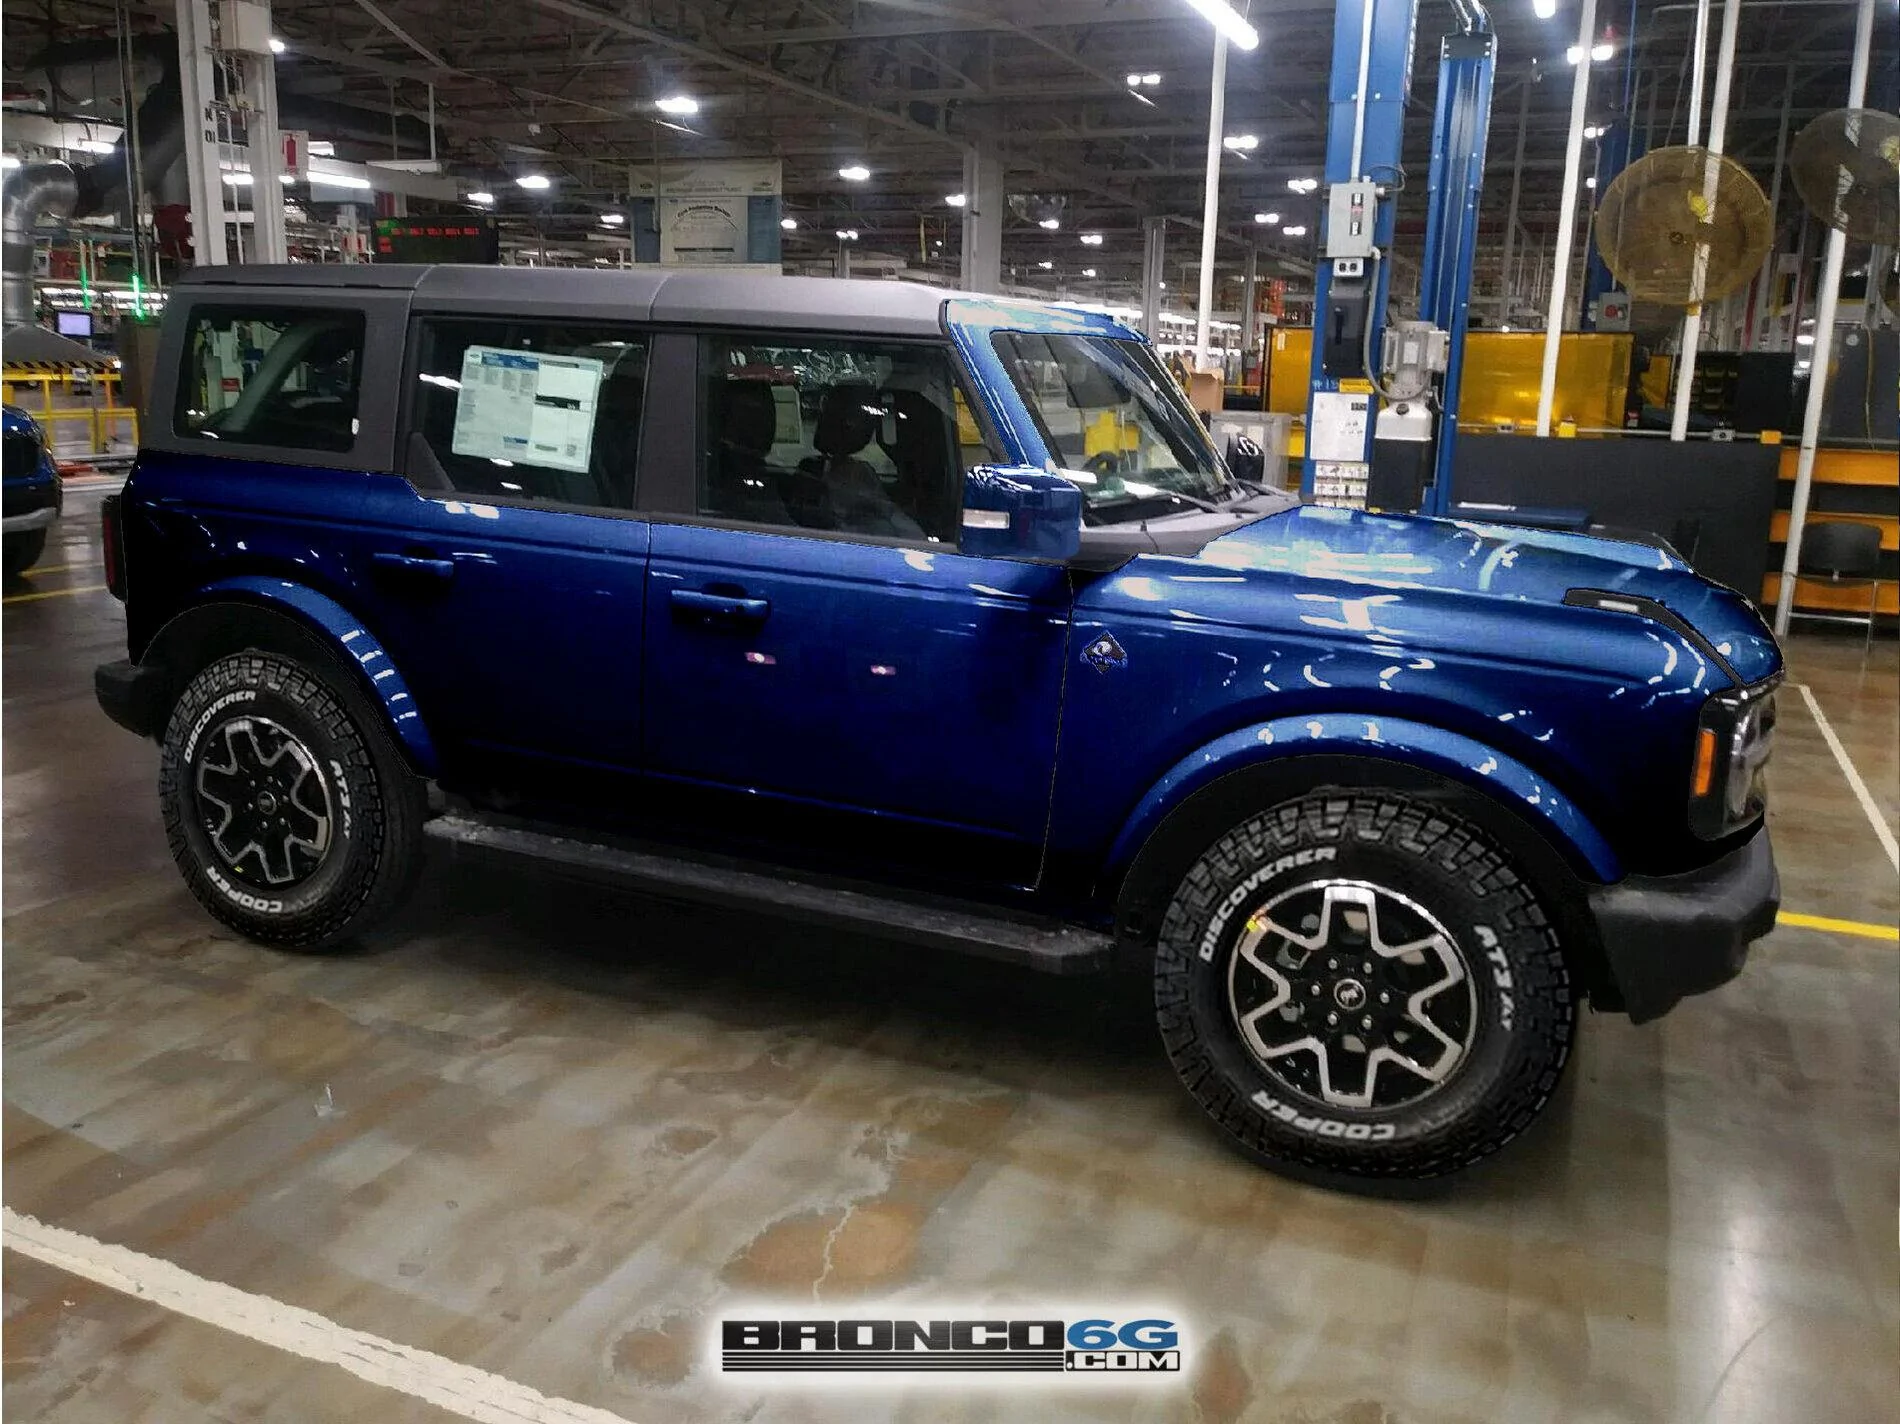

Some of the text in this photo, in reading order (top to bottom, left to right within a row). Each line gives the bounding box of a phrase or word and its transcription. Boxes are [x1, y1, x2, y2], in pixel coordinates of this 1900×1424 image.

[184, 690, 256, 765] DISCOVERER
[206, 865, 284, 914] COOPER
[1198, 847, 1337, 963] DISCOVERER
[1251, 1089, 1396, 1140] COOPER
